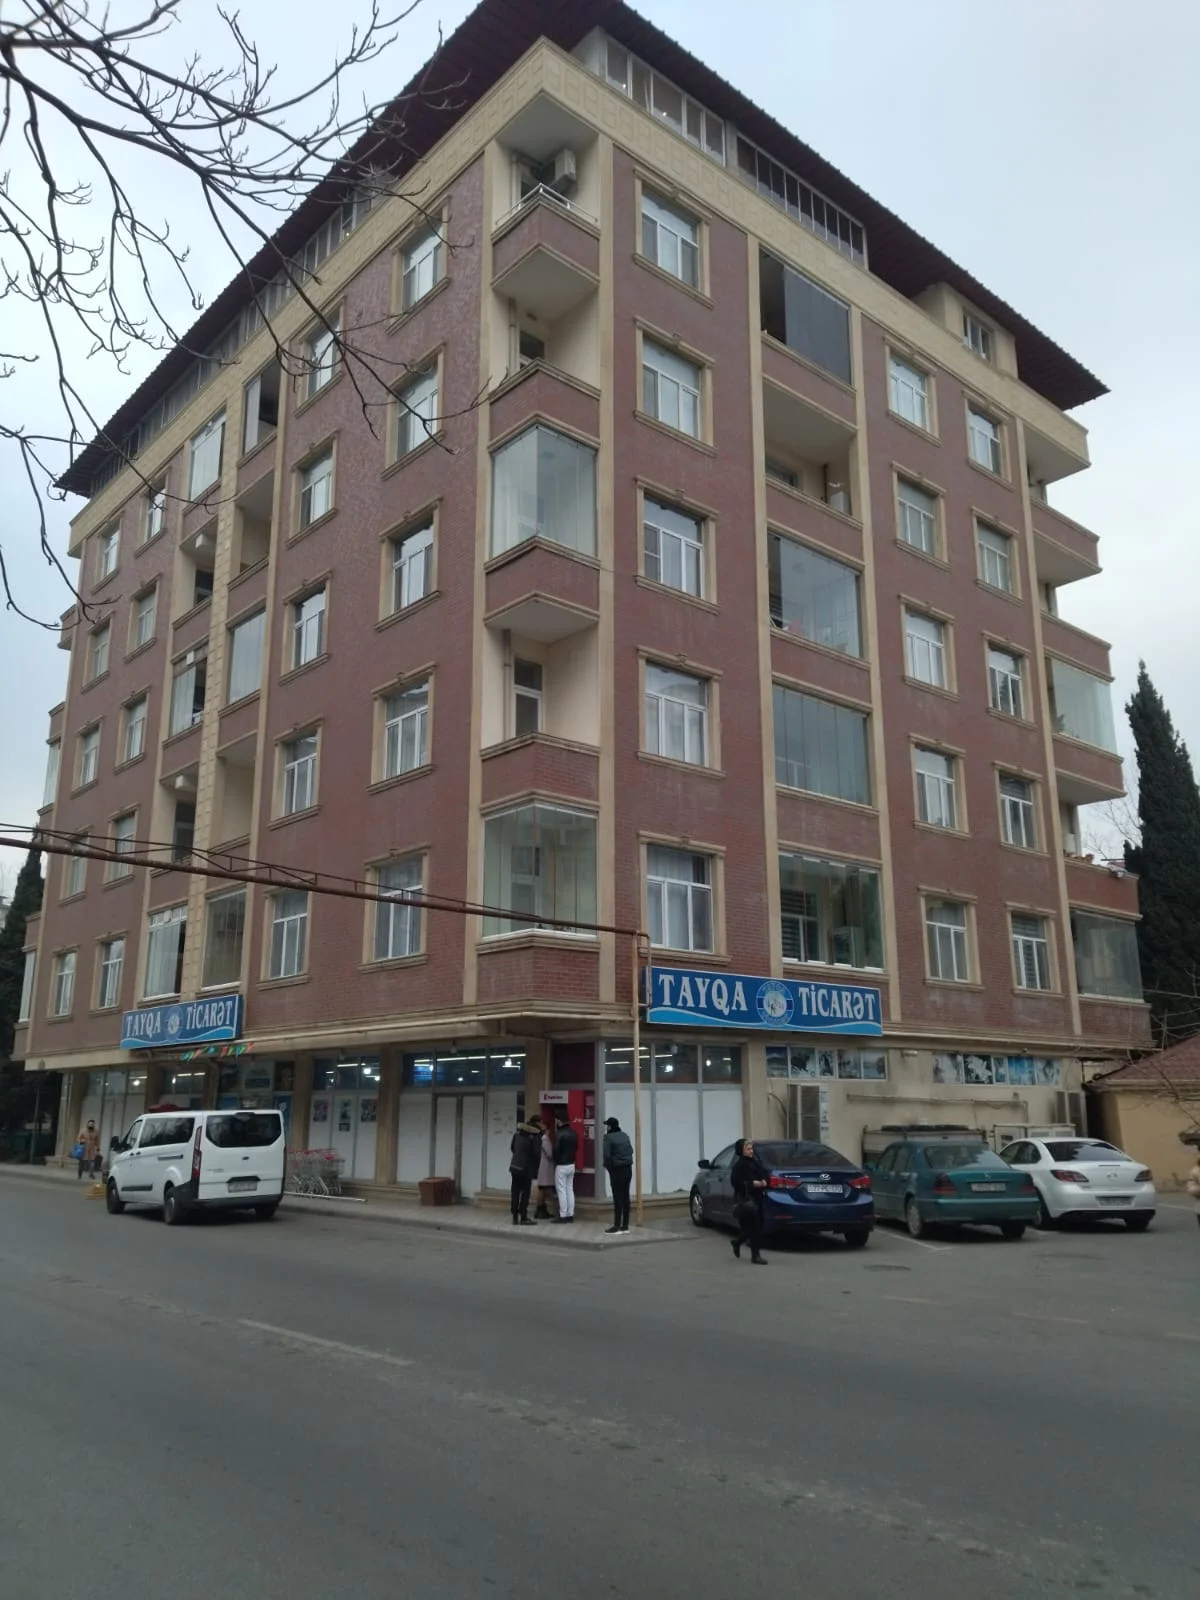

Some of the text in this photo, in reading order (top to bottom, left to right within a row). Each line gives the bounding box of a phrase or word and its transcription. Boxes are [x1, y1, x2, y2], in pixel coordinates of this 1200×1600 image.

[658, 974, 876, 1020] TAYQA TİCARƏT
[126, 1001, 233, 1039] TAYQA TİCARƏT
